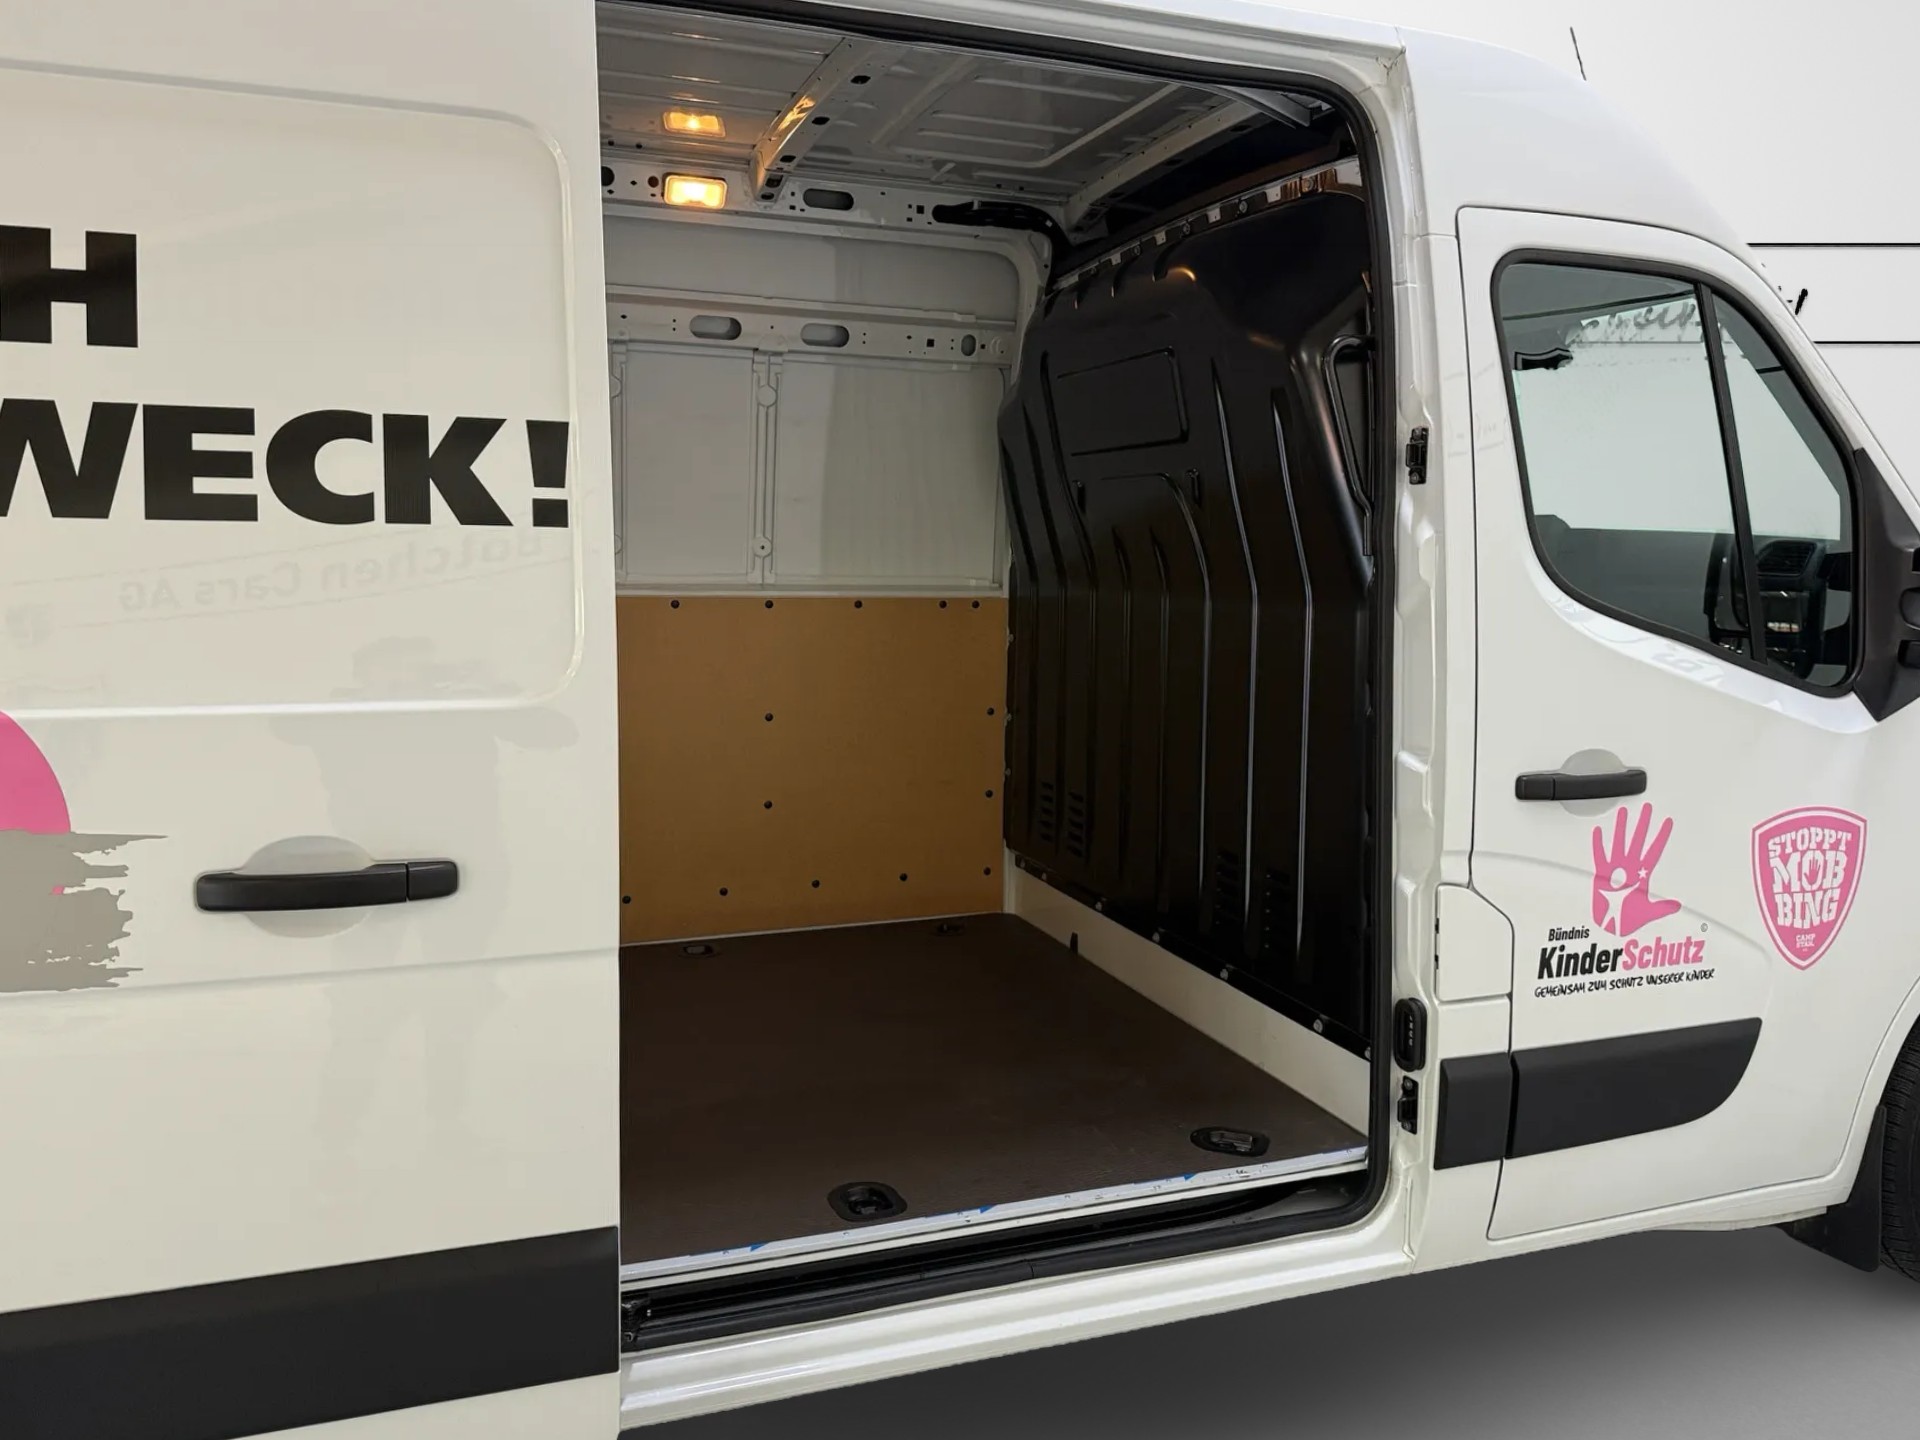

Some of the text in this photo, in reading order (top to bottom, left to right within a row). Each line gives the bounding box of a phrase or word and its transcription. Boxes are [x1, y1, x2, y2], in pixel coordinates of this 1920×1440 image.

[0, 223, 139, 348] H
[1767, 826, 1853, 858] STOPPT
[1769, 850, 1848, 893] MOB
[1774, 888, 1841, 929] BING
[1548, 925, 1590, 942] Bündnis
[1537, 936, 1706, 980] KinderSchutz
[1587, 979, 1607, 992] ZUM
[1609, 976, 1644, 990] SCHUTZ
[1645, 971, 1685, 986] UNSERER
